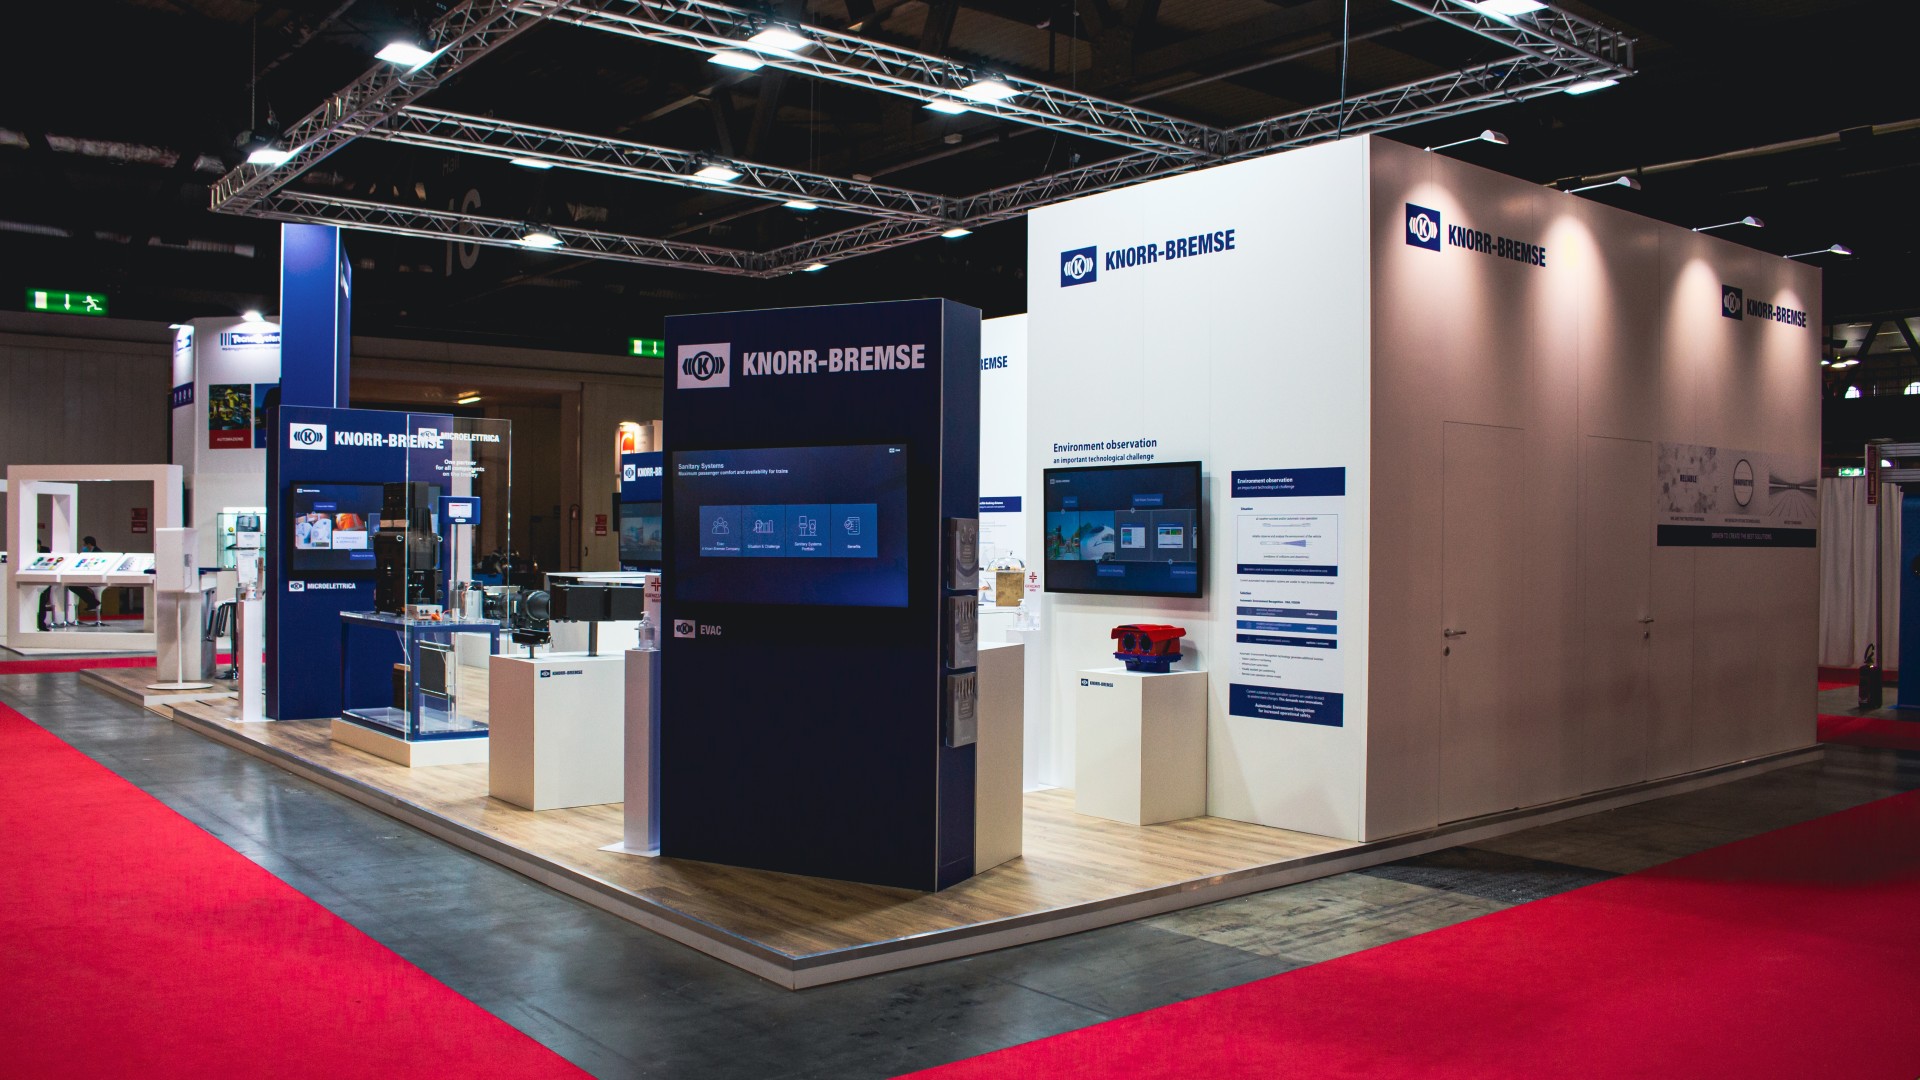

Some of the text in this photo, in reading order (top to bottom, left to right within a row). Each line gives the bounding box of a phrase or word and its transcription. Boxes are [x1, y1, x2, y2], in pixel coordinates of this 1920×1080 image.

[1105, 229, 1235, 271] KNORR-BREMSE
[1448, 224, 1546, 267] KNORR-BREMSE
[1746, 298, 1807, 328] KNORR-BREMSE
[742, 344, 926, 376] KNORR-BREMSE
[334, 431, 444, 450] KNORR-BREMSE
[440, 432, 500, 443] MICROELETTRICA
[1053, 438, 1157, 453] Environment observation
[1060, 457, 1088, 465] important
[1088, 454, 1126, 464] technological
[1126, 453, 1155, 462] challenge
[678, 463, 700, 471] Sanitary
[307, 582, 356, 590] MICROELETTRICA
[700, 625, 722, 636] EVAC
